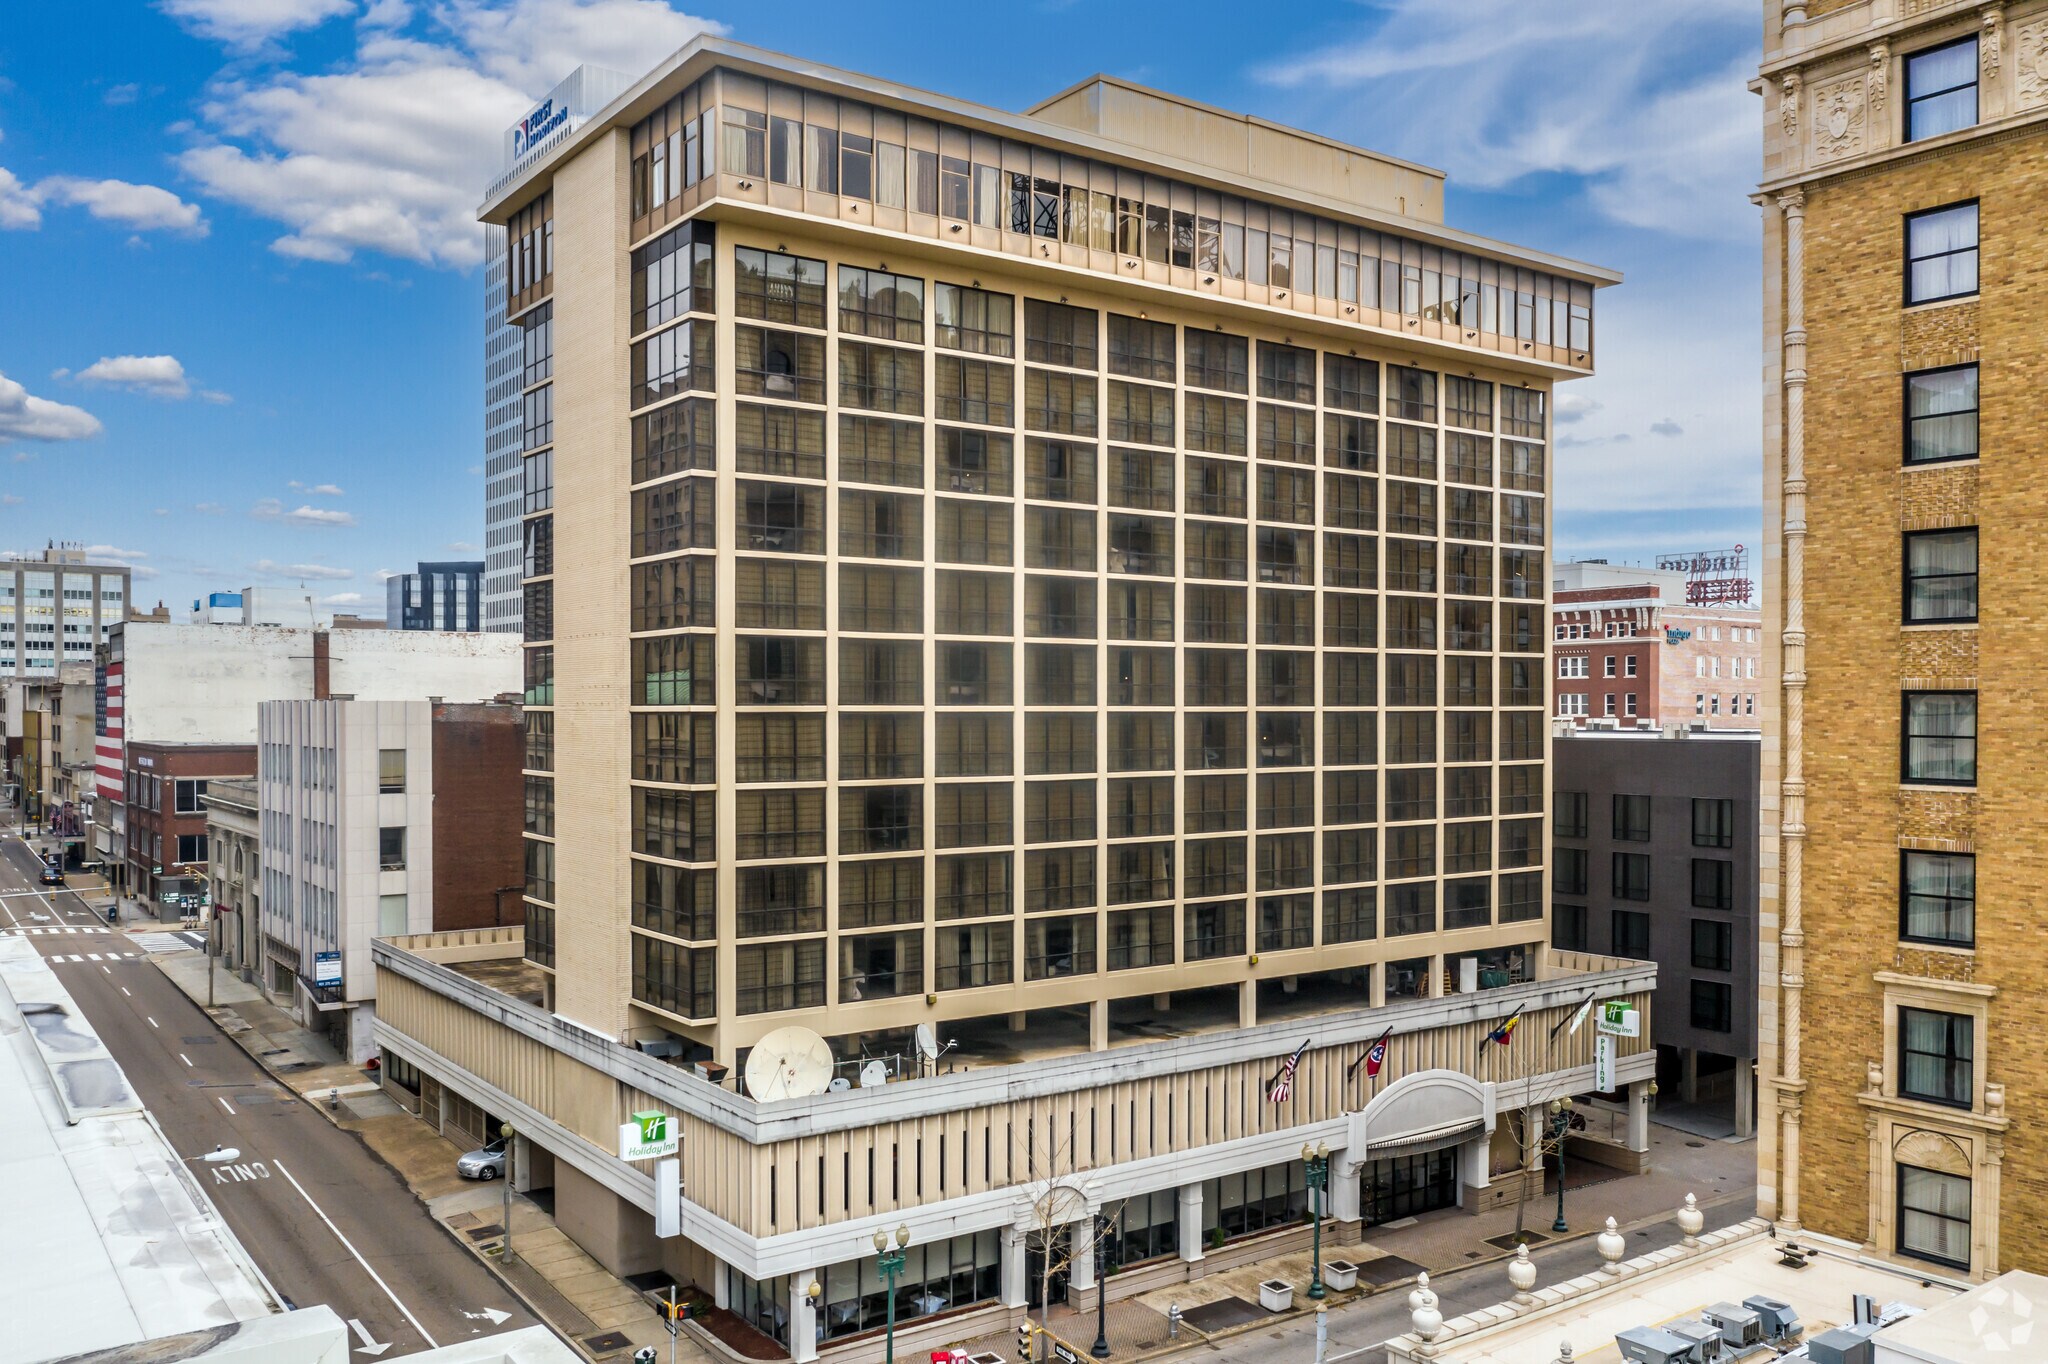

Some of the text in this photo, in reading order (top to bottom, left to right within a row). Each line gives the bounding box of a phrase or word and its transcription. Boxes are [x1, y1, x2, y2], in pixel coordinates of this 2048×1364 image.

[530, 99, 552, 132] FIRST
[530, 106, 568, 148] HORIZON
[1600, 1022, 1632, 1034] Holiday Inn
[629, 1142, 675, 1156] Holiday Inn
[211, 1162, 270, 1185] ONLY
